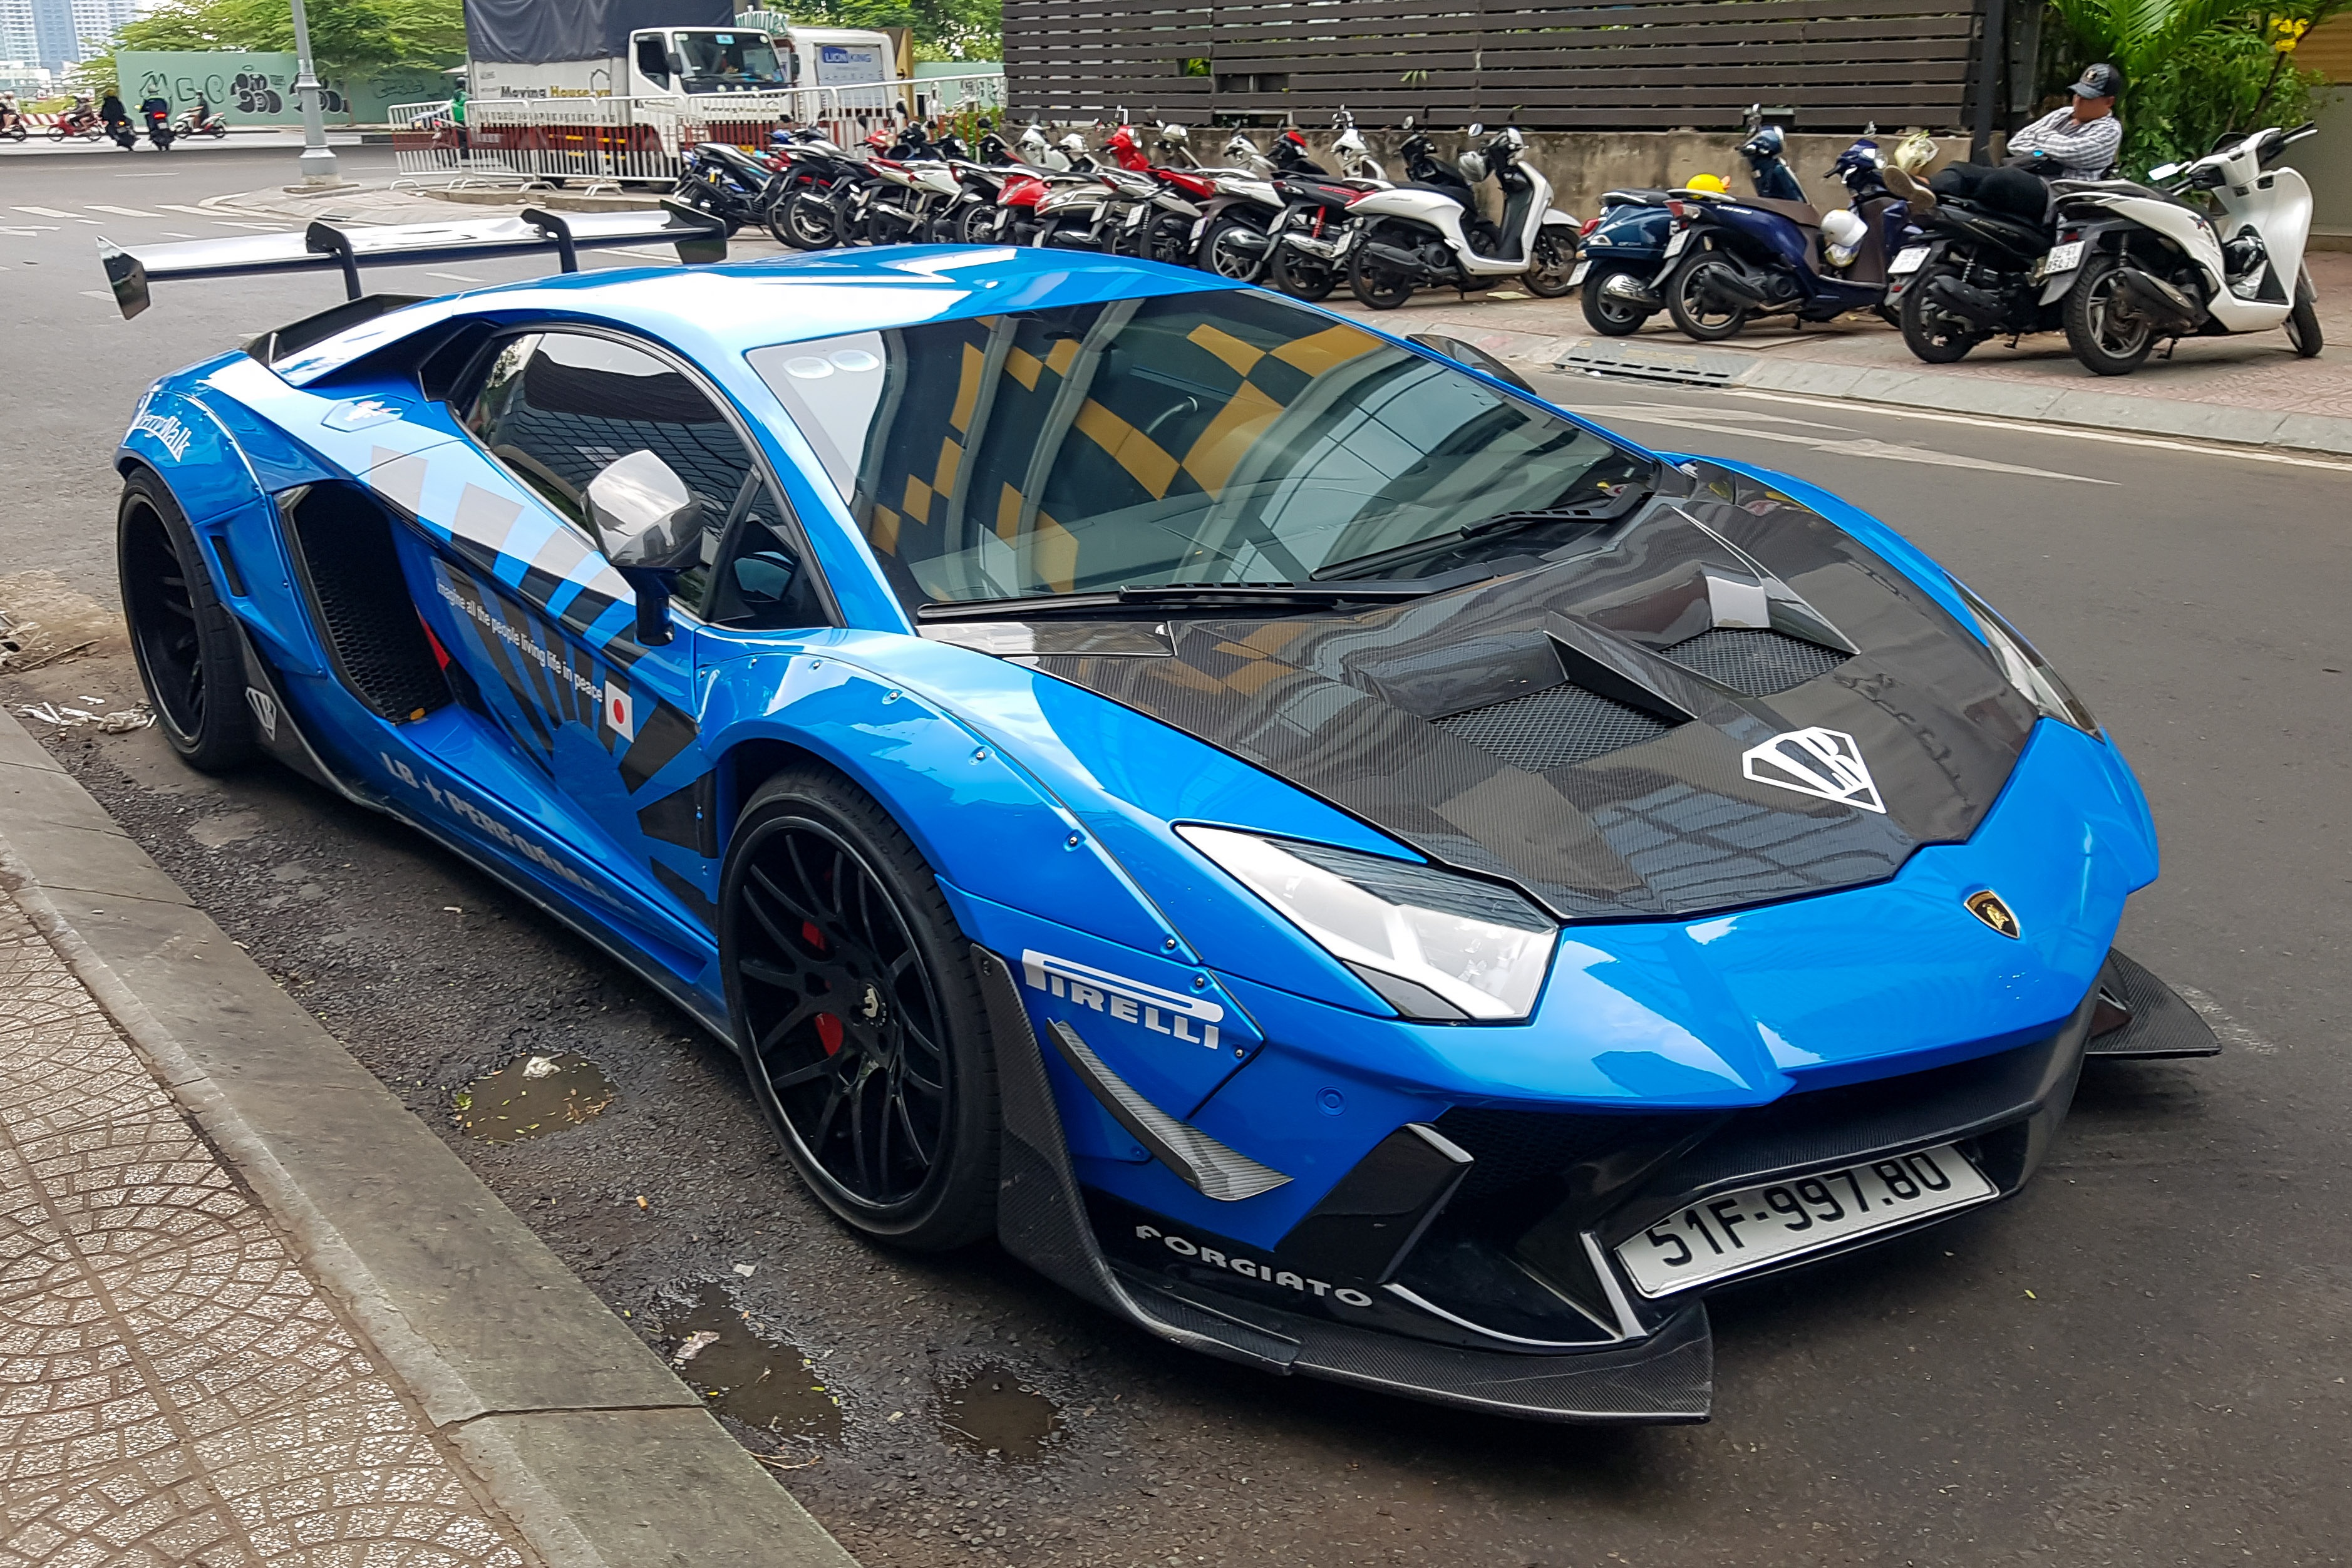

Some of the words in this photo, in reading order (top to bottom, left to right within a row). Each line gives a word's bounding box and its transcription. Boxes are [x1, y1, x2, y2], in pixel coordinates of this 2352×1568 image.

[467, 600, 476, 617] all
[477, 606, 490, 626] the
[492, 617, 520, 646] people
[563, 661, 573, 683] in
[574, 673, 603, 703] peace
[1021, 948, 1224, 1050] PIRELLI
[1644, 1151, 1952, 1267] 51F-997.80
[1135, 1225, 1373, 1307] FORGIATO
